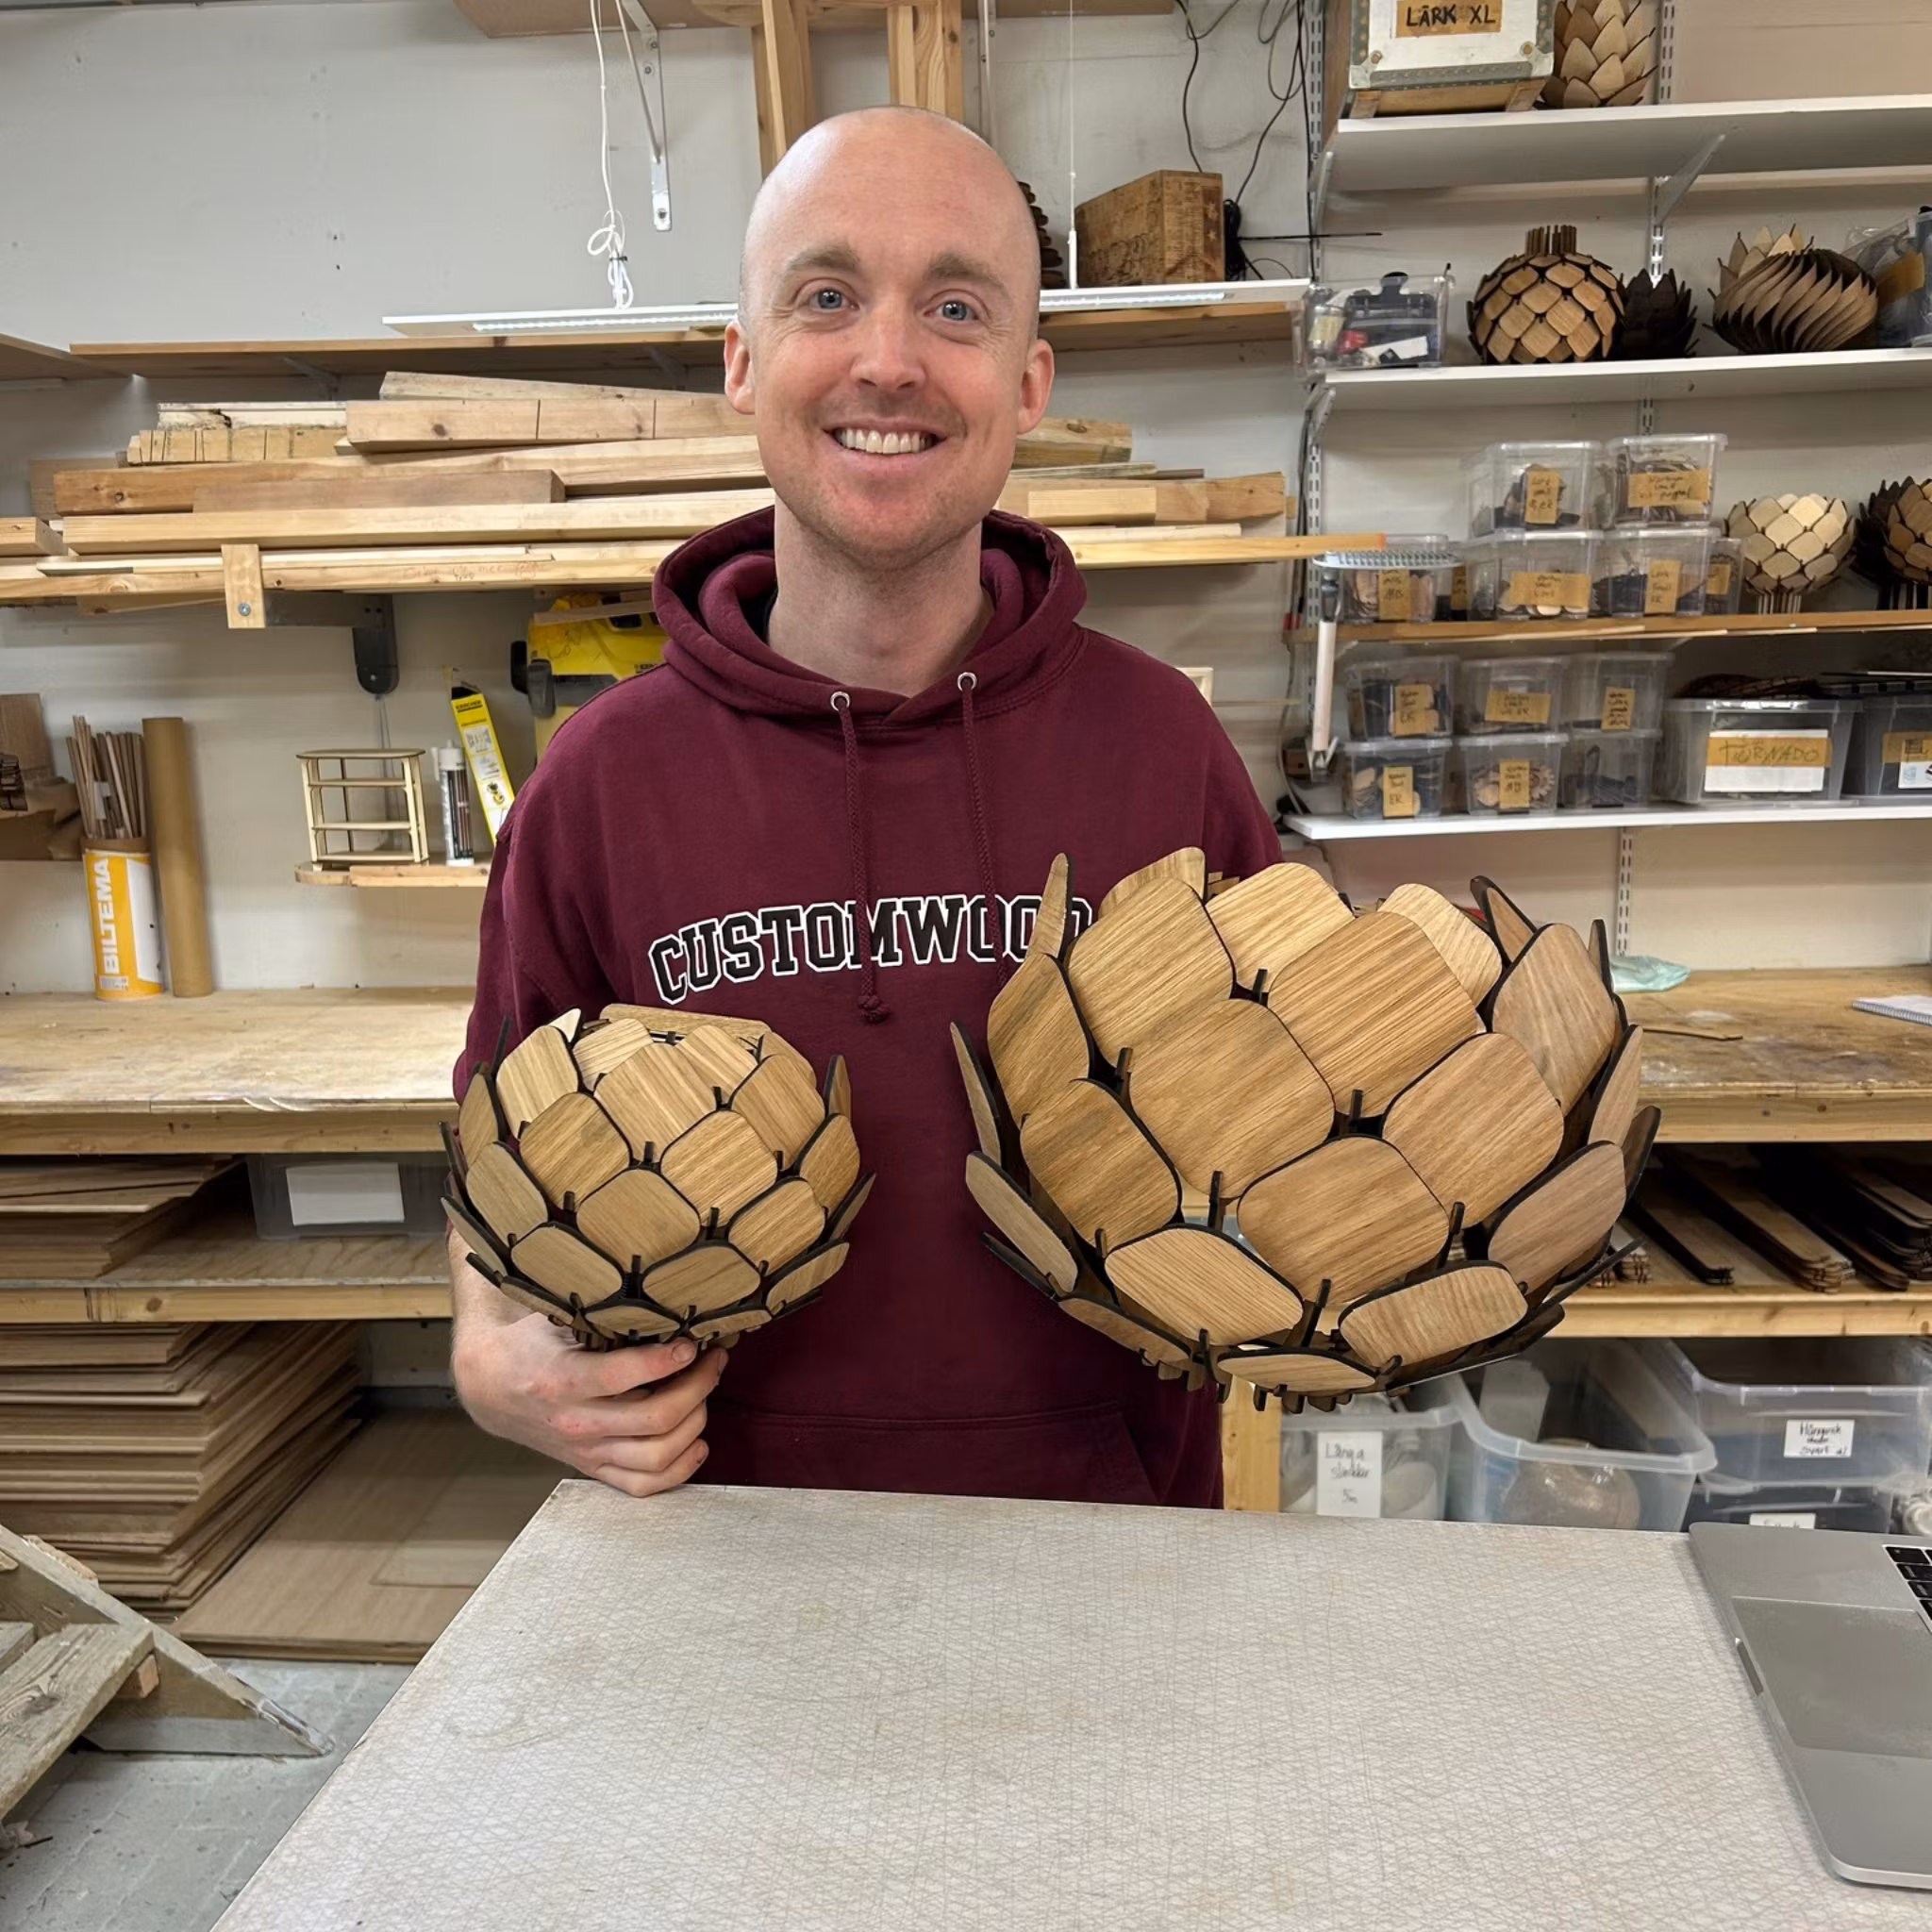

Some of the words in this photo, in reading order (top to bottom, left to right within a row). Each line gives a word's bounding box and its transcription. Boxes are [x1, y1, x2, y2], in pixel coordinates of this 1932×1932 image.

[1406, 4, 1457, 26] LÄRK
[1469, 4, 1496, 25] XL
[93, 858, 121, 975] BILTEMA
